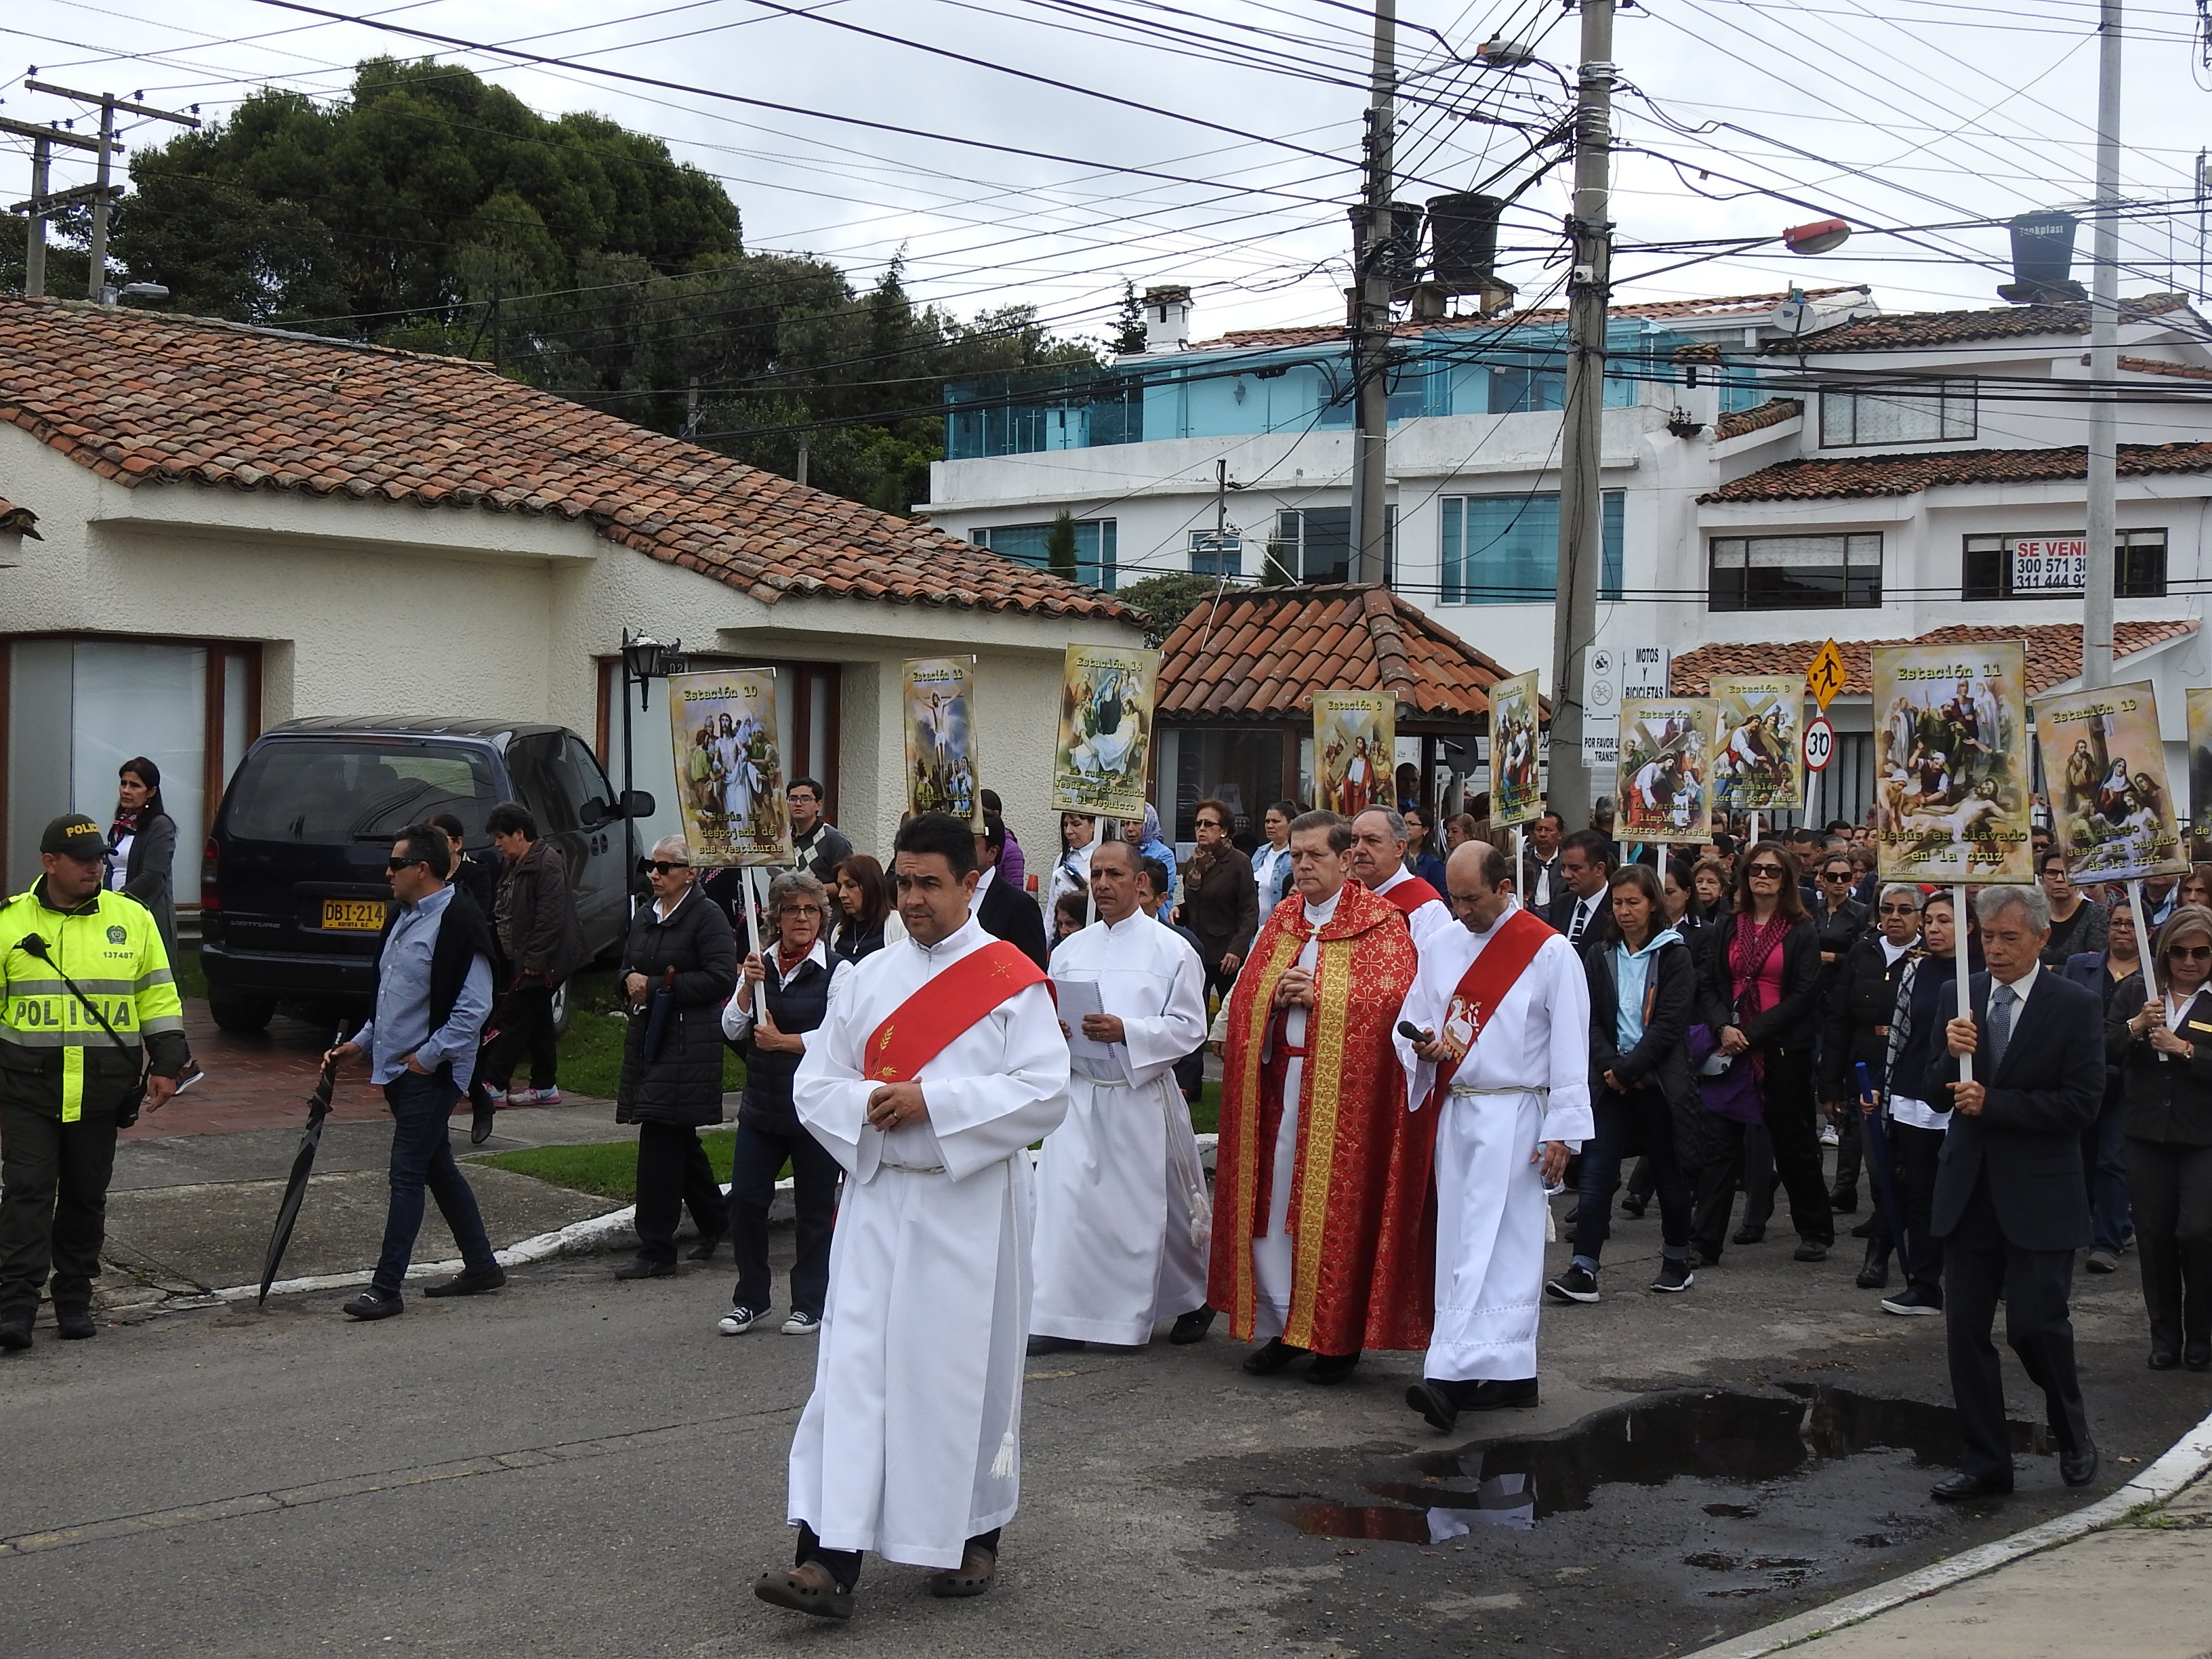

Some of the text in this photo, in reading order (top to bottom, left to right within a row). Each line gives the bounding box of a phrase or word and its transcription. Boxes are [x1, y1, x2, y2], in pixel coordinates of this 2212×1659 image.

[2018, 541, 2086, 557] SE VEN
[2018, 558, 2041, 573] 300
[2046, 558, 2068, 573] 571
[2017, 575, 2039, 589] 311
[2045, 574, 2069, 588] 444
[1635, 648, 1659, 663] MOTOS
[1076, 657, 1143, 672] Estación 14
[1898, 663, 2003, 680] Estación 11
[913, 670, 964, 682] Estación 12
[1643, 668, 1648, 682] Y
[684, 686, 758, 701] Estación 10
[1626, 687, 1664, 699] BICICLETAS
[1729, 684, 1778, 693] Estación
[1328, 700, 1383, 711] Estación 2
[2052, 699, 2137, 724] Estación 13
[1639, 710, 1702, 719] Estación 6
[1584, 737, 1595, 748] POR
[1597, 737, 1614, 748] FAVOR
[1807, 732, 1830, 757] 30
[1069, 767, 1134, 782] El cuerpo de
[1736, 772, 1776, 781] mujeres
[1054, 779, 1145, 798] Jesús es colocado
[1727, 782, 1779, 791] Jerusalén
[1077, 795, 1088, 804] el
[1092, 798, 1136, 811] sepulcro
[1746, 795, 1764, 803] por
[1769, 794, 1799, 802] Jesús
[711, 811, 760, 821] Jesús es
[1639, 814, 1692, 823] limpia el
[701, 825, 776, 839] despojado de
[1620, 826, 1711, 837] rostro de Jesús
[1879, 827, 2028, 842] Jesús es clavado
[2096, 824, 2139, 838] cuerpo
[2148, 819, 2164, 831] de
[2194, 825, 2211, 836] de
[699, 843, 783, 855] sus vestiduras
[2067, 836, 2178, 857] Jesús es bajado
[1911, 849, 2004, 863] en la cruz
[2088, 855, 2163, 872] de la cruz
[14, 1000, 131, 1027] POLICIA
